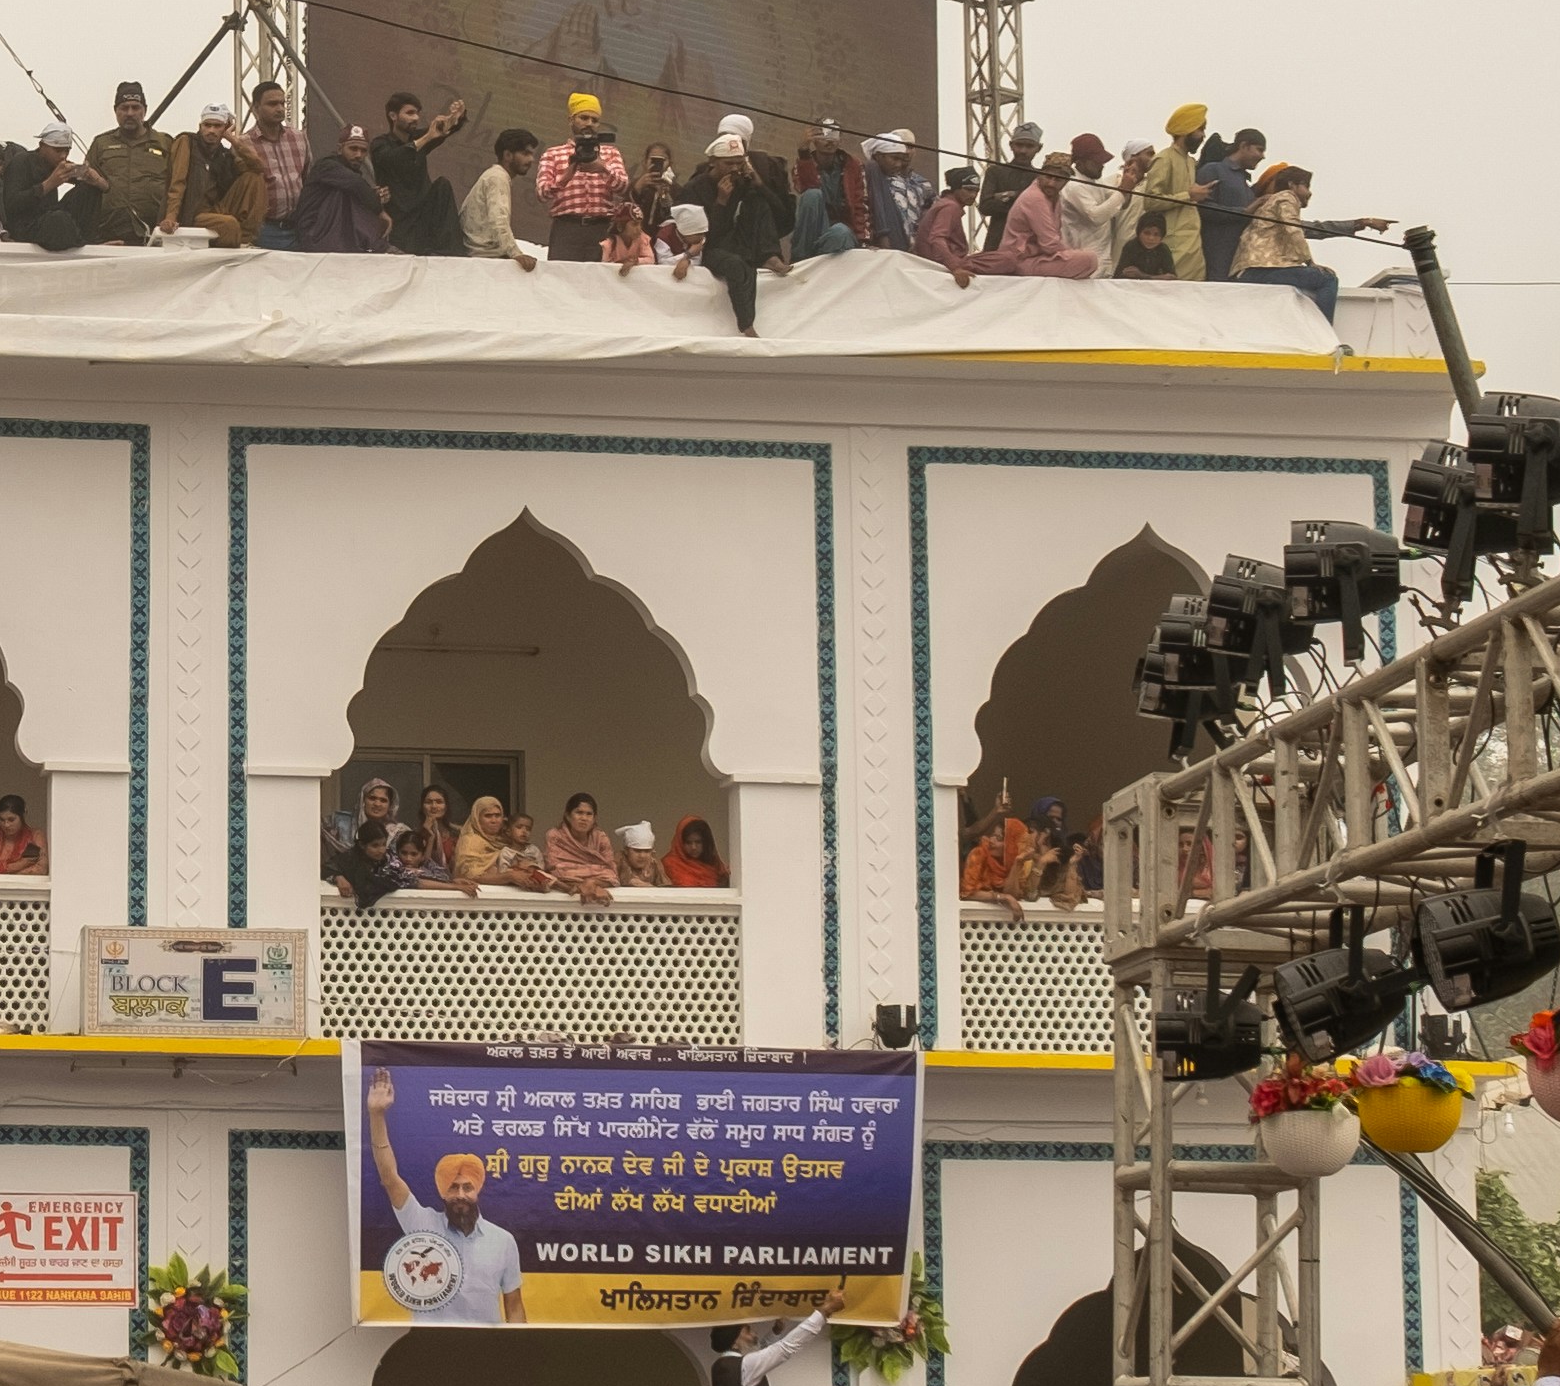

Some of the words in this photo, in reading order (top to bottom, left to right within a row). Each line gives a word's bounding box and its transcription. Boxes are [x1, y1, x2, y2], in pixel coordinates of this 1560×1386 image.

[111, 975, 189, 993] BLOCK
[202, 958, 259, 1021] E
[486, 1045, 523, 1059] ਅਕਾਲ
[428, 1084, 490, 1106] ਜਥੇਦਾਰ
[523, 1091, 576, 1108] ਅਕਾਲ
[630, 1087, 682, 1110] ਸਾਹਿਬ
[696, 1088, 735, 1111] ਭਾਈ
[741, 1095, 802, 1112] ਜਗਤਾਰ
[808, 1090, 844, 1113] ਸਿੰਘ
[850, 1097, 900, 1114] ਹਵਾਰਾ
[452, 1113, 485, 1135] ਅਤੇ
[491, 1119, 546, 1137] ਵਰਲਡ
[553, 1115, 591, 1138] ਸਿੱਖ
[725, 1124, 767, 1148] ਸਮੂਹ
[773, 1124, 806, 1141] ਸਾਧ
[812, 1118, 855, 1142] ਸੰਗਤ
[518, 1155, 551, 1182] ਗੁਰੂ
[560, 1156, 614, 1176] ਨਾਨਕ
[622, 1150, 655, 1176] ਦੇਵ
[662, 1151, 686, 1176] ਜੀ
[693, 1151, 710, 1176] ਦੇ
[782, 1153, 845, 1183] ਉਤਸਵ
[28, 1201, 124, 1213] EMERGENCY
[554, 1185, 603, 1211] ਦੀਆਂ
[611, 1187, 644, 1212] ਲੱਖ
[652, 1187, 686, 1213] ਲੱਖ
[693, 1189, 778, 1214] ਵਧਾਈਆਂ
[43, 1216, 124, 1251] EXIT
[536, 1243, 634, 1263] WORLD
[645, 1245, 712, 1264] SIKH
[724, 1246, 893, 1265] PARLIAMENT
[20, 1290, 44, 1301] 1122
[46, 1291, 97, 1301] NANKANA
[100, 1291, 132, 1301] SAHIB
[600, 1281, 721, 1310] ਖਾਲਿਸਤਾਨ
